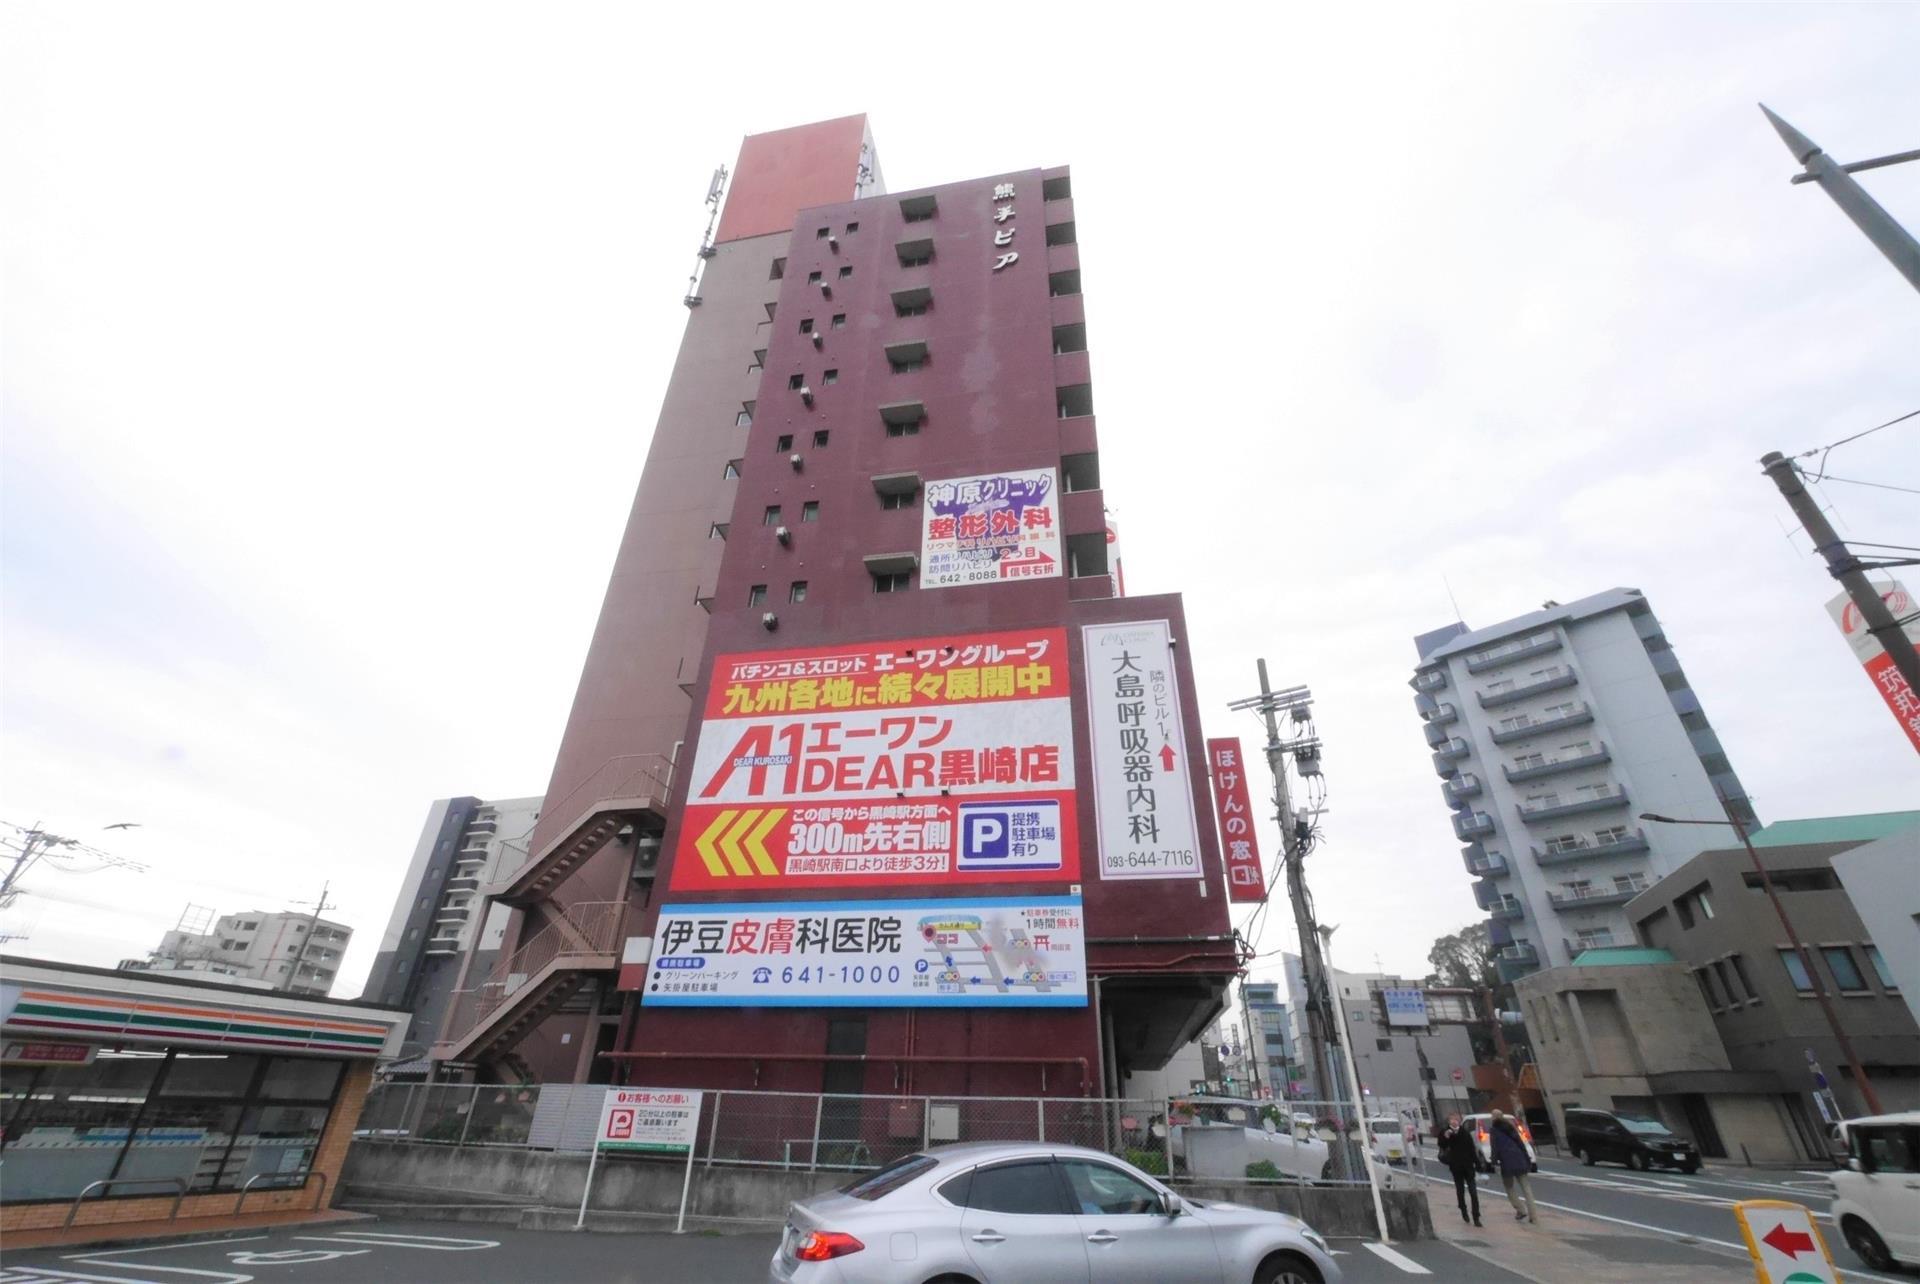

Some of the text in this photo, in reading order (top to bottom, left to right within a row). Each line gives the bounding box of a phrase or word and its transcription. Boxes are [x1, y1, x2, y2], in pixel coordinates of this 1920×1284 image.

[928, 474, 1052, 508] 神原クリニック
[928, 507, 1053, 541] 整形外科
[1001, 546, 1035, 560] 2つ目
[1010, 564, 1054, 577] 信号右折
[731, 639, 1049, 680] パチンコ&スロット エーワングループ
[722, 662, 1052, 715] 九州各地に続々展開中
[806, 716, 953, 753] エーワン
[1111, 650, 1160, 844] 大島呼吸器内科
[733, 754, 793, 767] DEAR KUROSAKI
[802, 744, 1059, 793] DEAR黒崎店
[793, 804, 952, 822] この信号から黒崎駅方面へ
[1011, 812, 1041, 826] 提携
[1216, 750, 1252, 885] ほけんの窓口
[788, 820, 951, 855] 300m先右側
[972, 818, 1003, 853] P
[1011, 827, 1056, 841] 駐車場
[1011, 843, 1039, 857] 有り
[1107, 849, 1194, 868] 093-644-7116
[661, 916, 903, 955] 伊豆皮膚科医院
[1026, 918, 1079, 930] 1時間無料
[781, 965, 901, 984] 641-1000
[627, 1092, 689, 1104] お客様へのお願い
